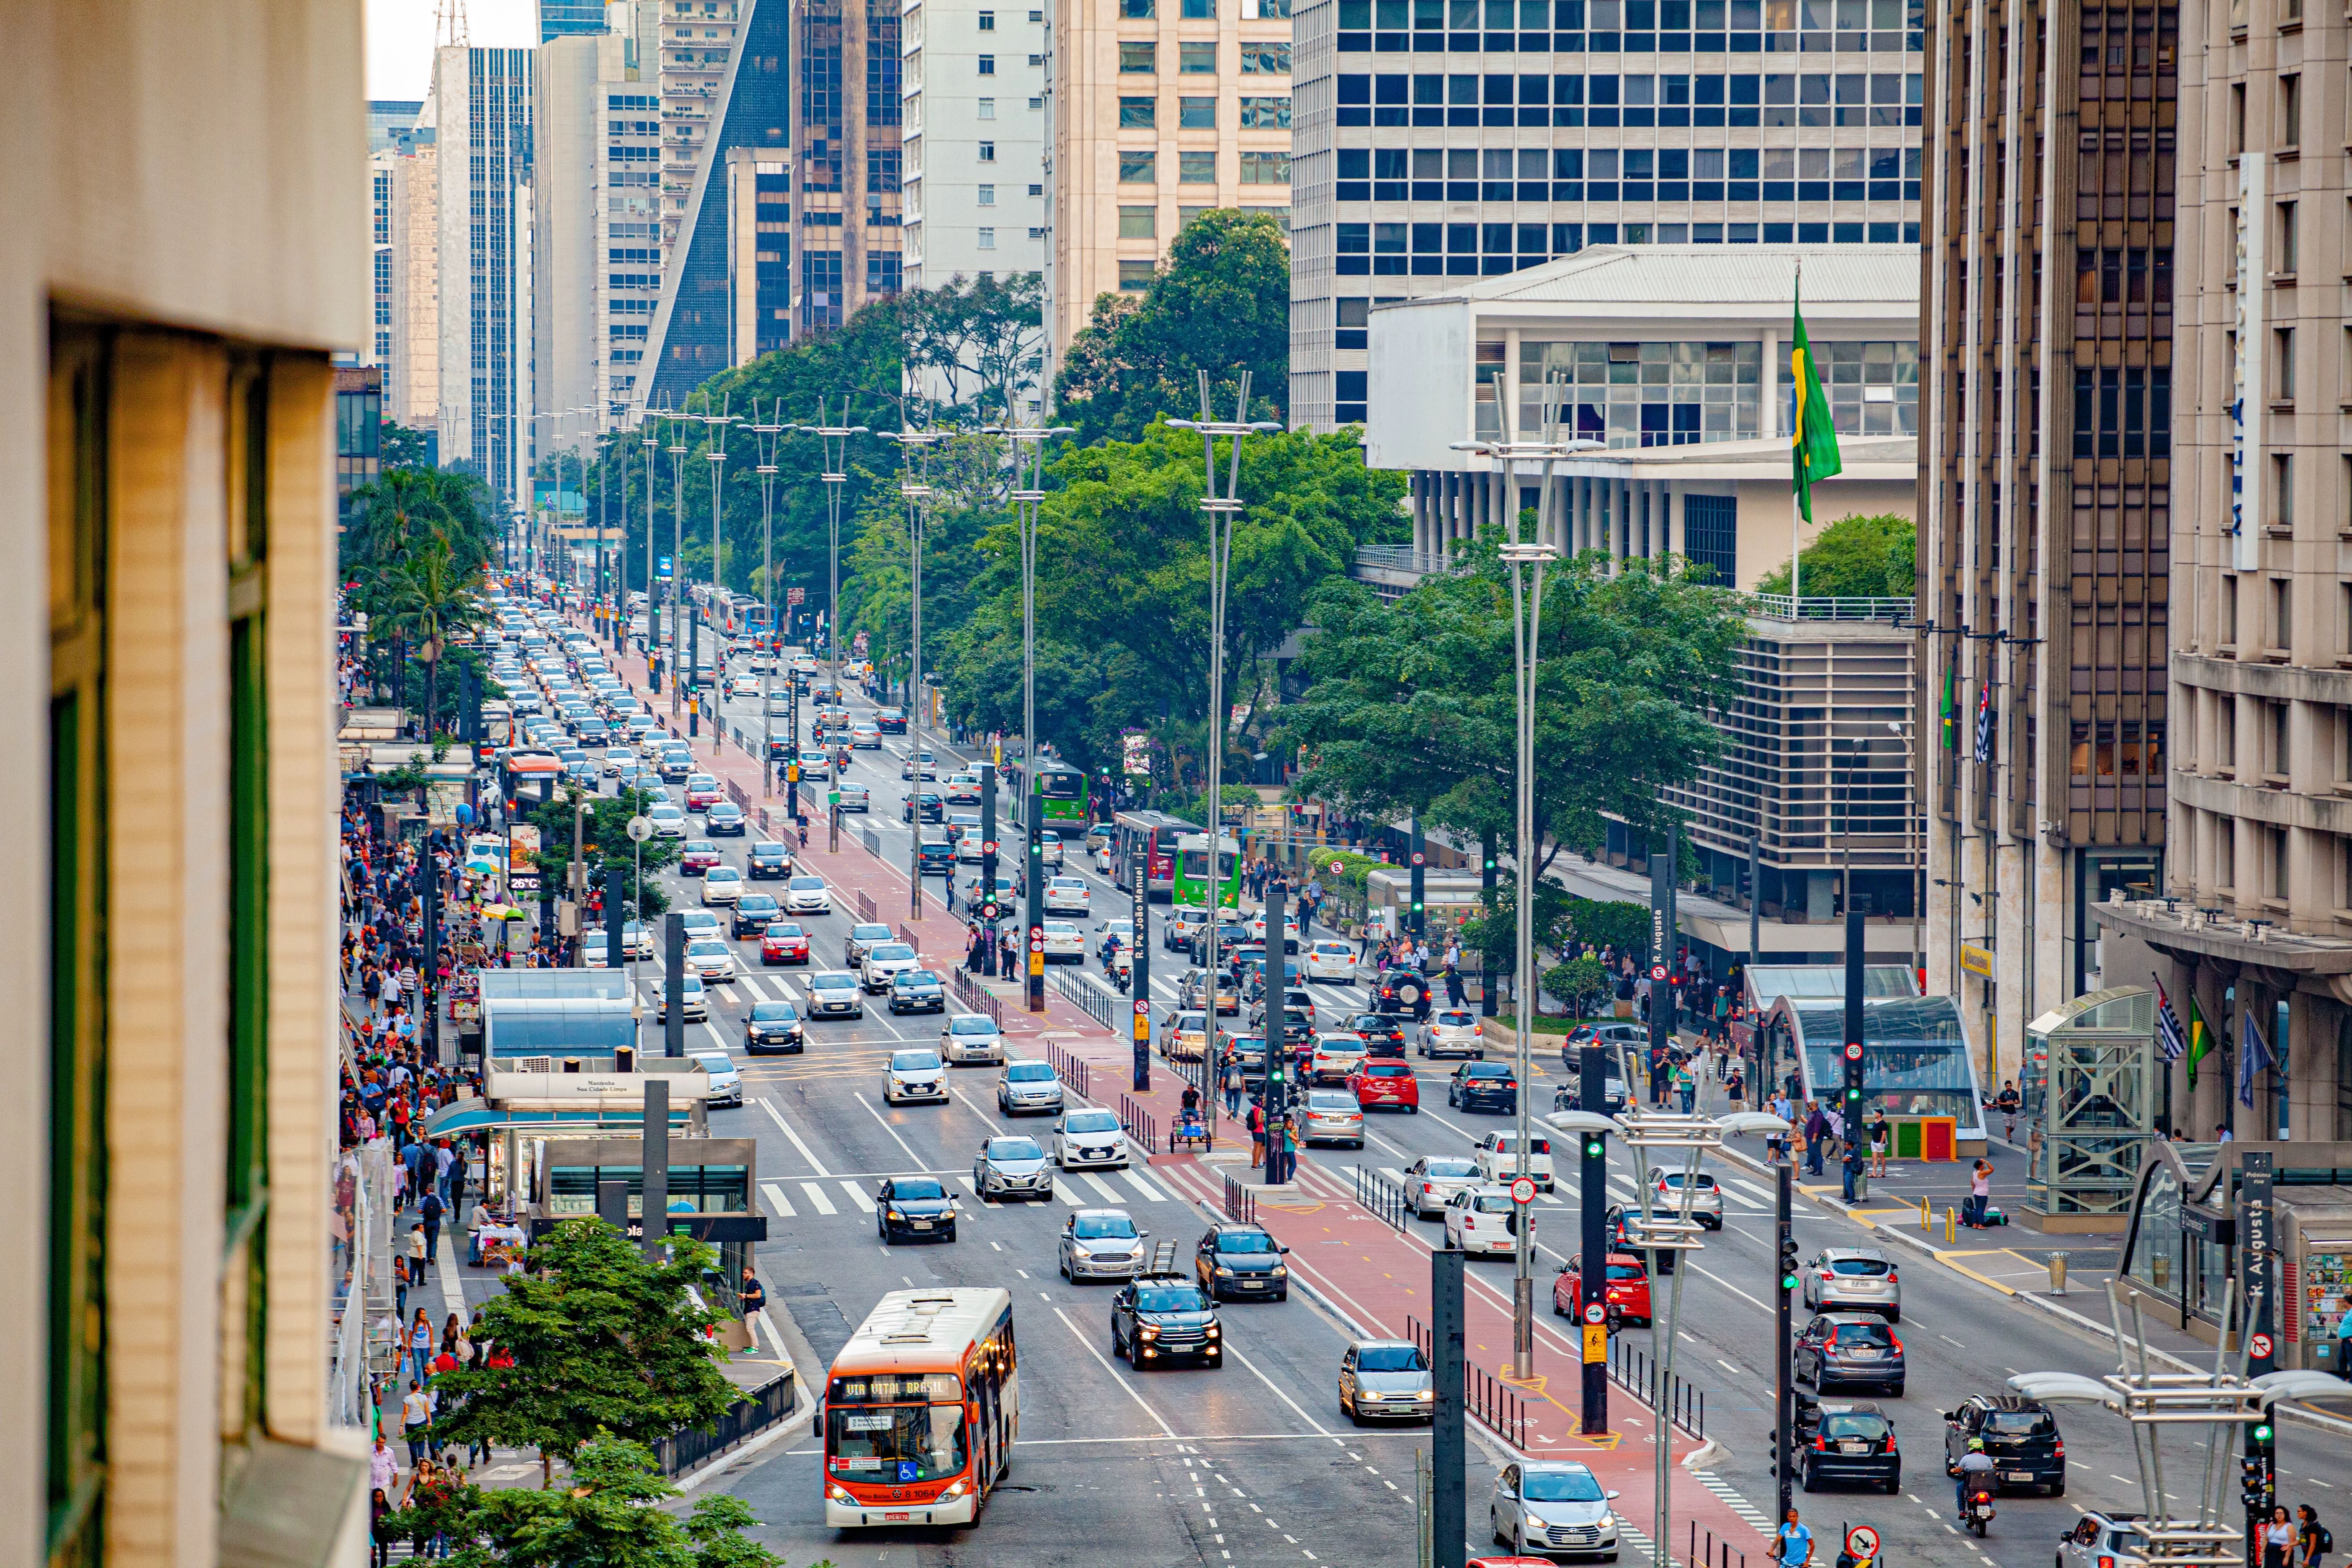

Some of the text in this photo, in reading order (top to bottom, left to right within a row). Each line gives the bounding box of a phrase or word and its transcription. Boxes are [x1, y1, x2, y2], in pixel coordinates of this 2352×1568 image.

[511, 878, 538, 888] 26°C
[1135, 867, 1144, 959] R. Pe. João Manuel
[1653, 909, 1664, 962] R. Augusta
[2248, 1199, 2266, 1275] Augusta
[846, 1381, 943, 1395] VIA VITAL BRASIL
[915, 1489, 935, 1498] 1064
